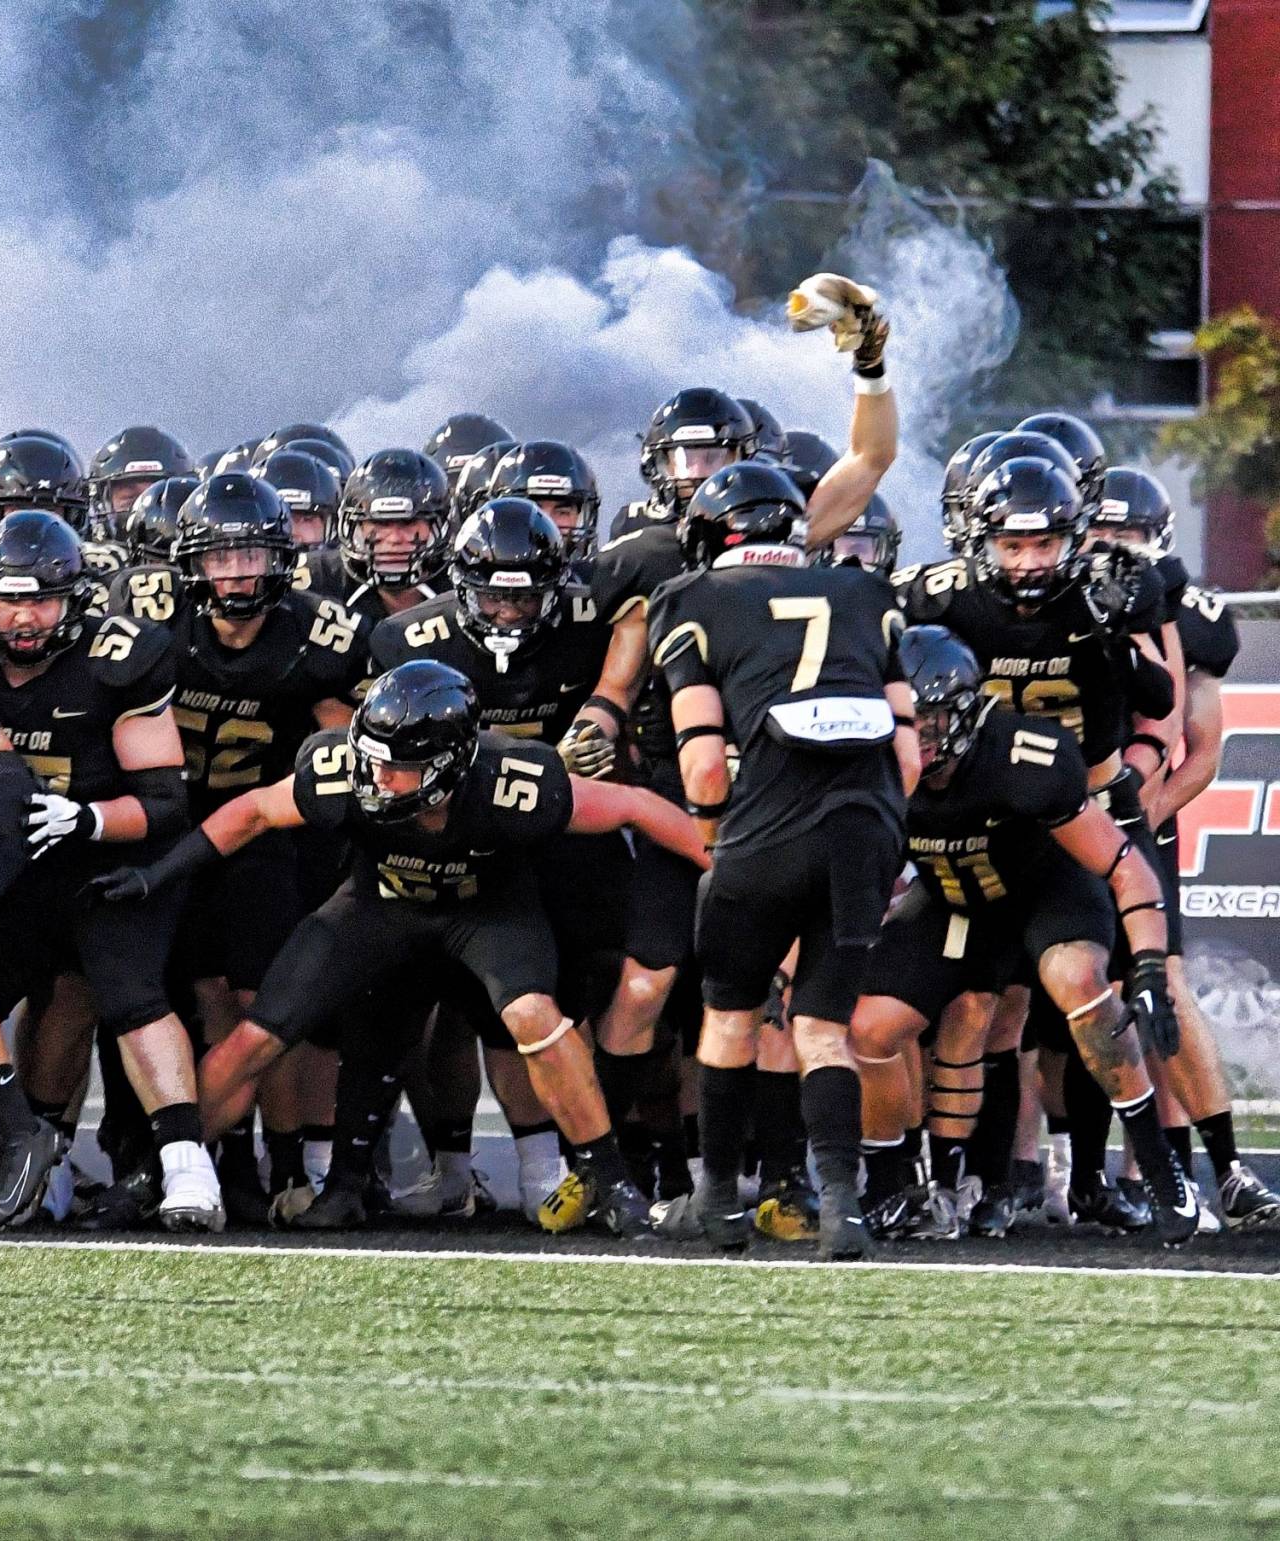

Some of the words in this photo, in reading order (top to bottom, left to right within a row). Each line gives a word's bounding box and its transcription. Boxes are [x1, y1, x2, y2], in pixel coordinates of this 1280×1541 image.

[742, 551, 799, 565] Riddell
[128, 571, 175, 621] 52
[496, 575, 526, 583] Riddell
[88, 615, 140, 661] 57
[309, 599, 363, 654] 52
[404, 615, 450, 649] 5
[769, 596, 831, 693] 7
[989, 657, 1031, 677] NOIR
[1030, 661, 1048, 674] ET
[1047, 655, 1071, 676] OR
[179, 688, 220, 710] NOIR
[220, 700, 237, 711] ET
[236, 699, 261, 716] OR
[479, 708, 518, 722] NOIR
[536, 703, 559, 716] OR
[13, 732, 27, 745] ET
[28, 730, 52, 751] OR
[1010, 729, 1059, 767] 11
[312, 743, 354, 796] 51
[493, 756, 545, 812] 51
[385, 853, 425, 871] NOIR
[445, 862, 468, 875] OR
